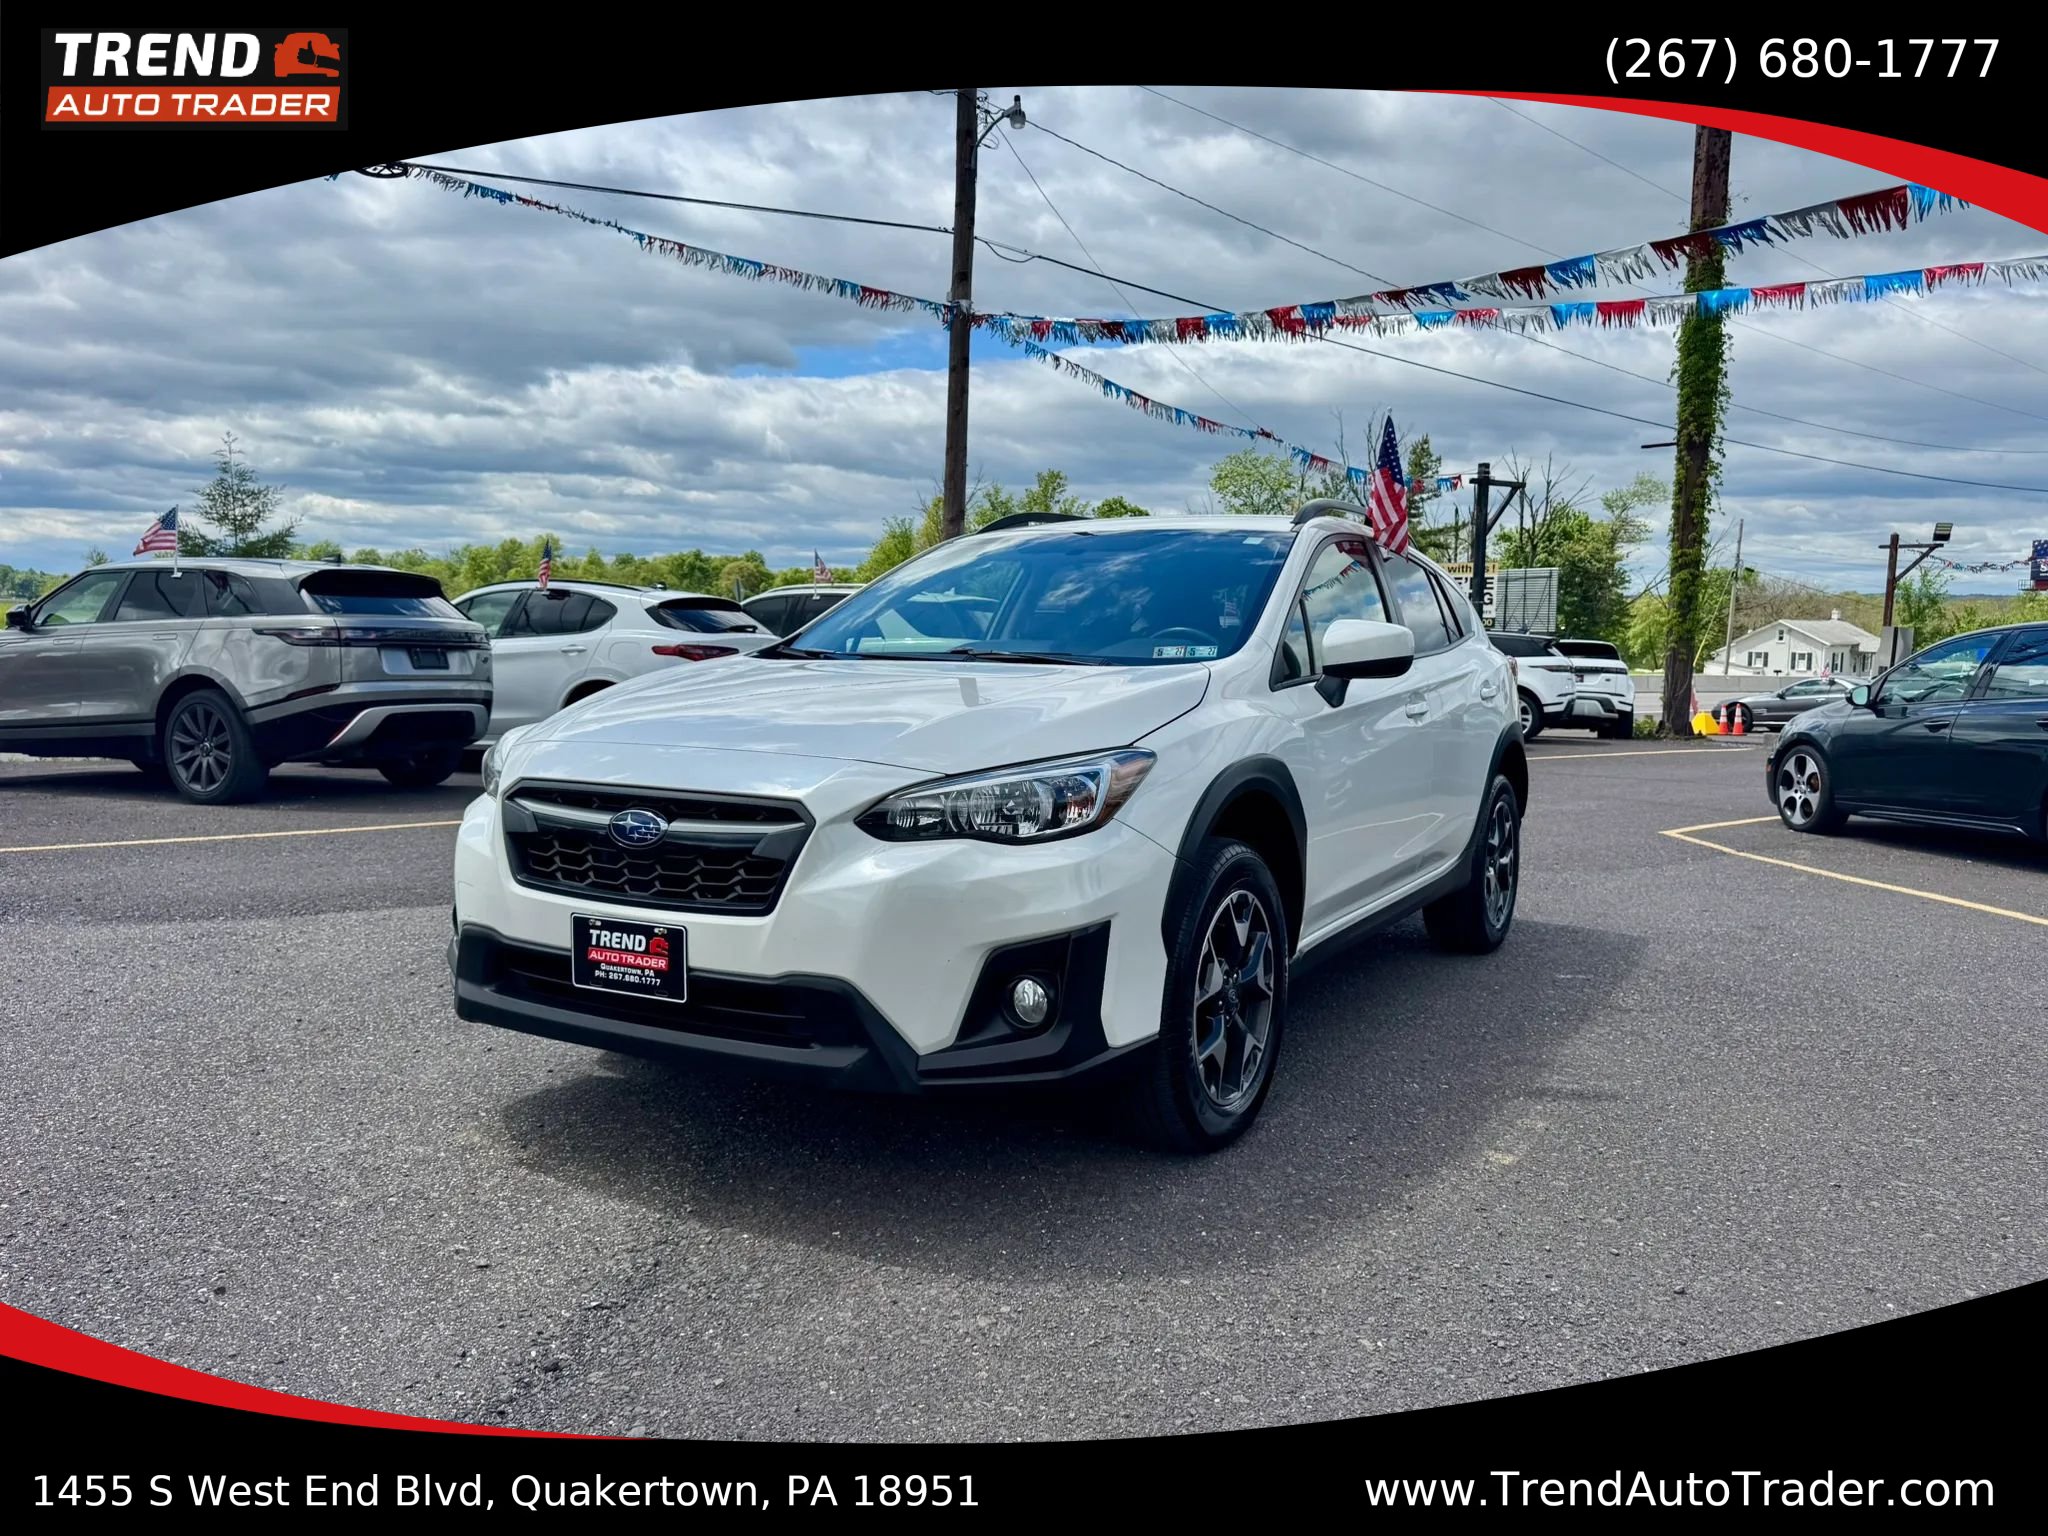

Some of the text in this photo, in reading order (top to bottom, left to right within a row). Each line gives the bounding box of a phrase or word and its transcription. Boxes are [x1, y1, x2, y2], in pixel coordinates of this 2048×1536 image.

[1447, 564, 1472, 573] with
[589, 929, 646, 952] TREND
[589, 950, 666, 968] AUTO TRADER
[608, 972, 661, 986] 267.680.1777
[645, 968, 655, 977] PA
